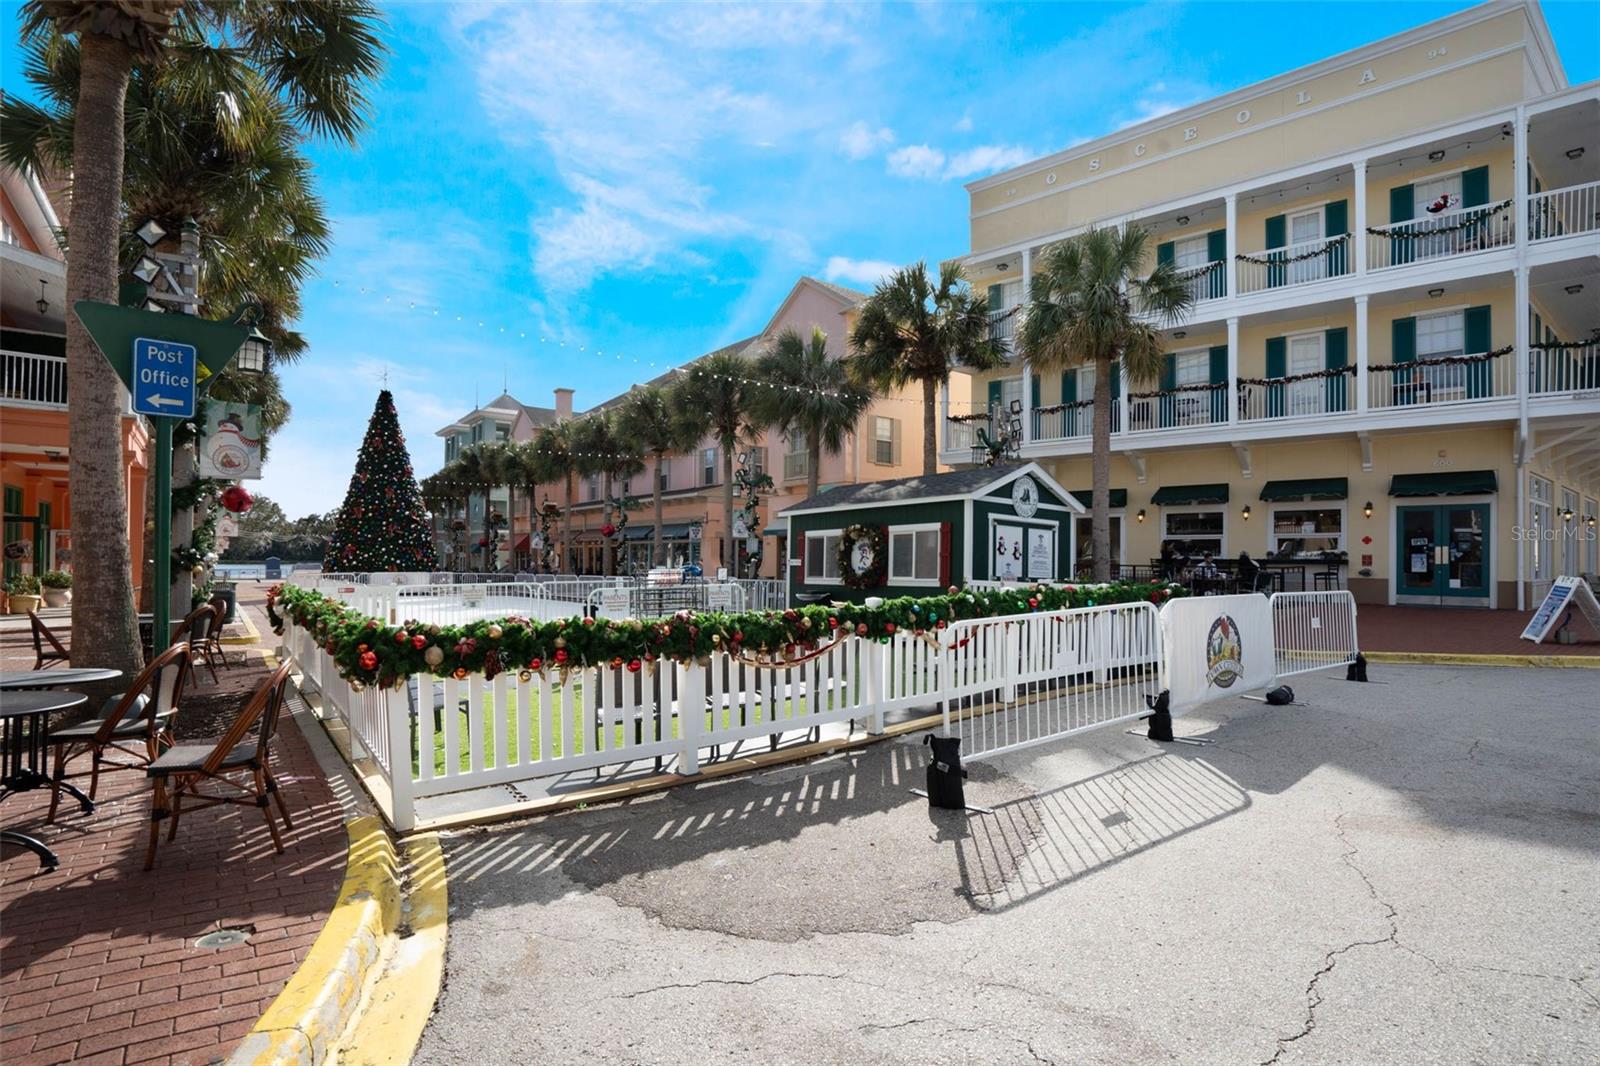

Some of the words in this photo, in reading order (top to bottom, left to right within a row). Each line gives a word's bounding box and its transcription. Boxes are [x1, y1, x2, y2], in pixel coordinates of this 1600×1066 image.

[1045, 67, 1377, 185] OSCEOLA
[147, 346, 184, 364] Post
[140, 368, 190, 388] Office
